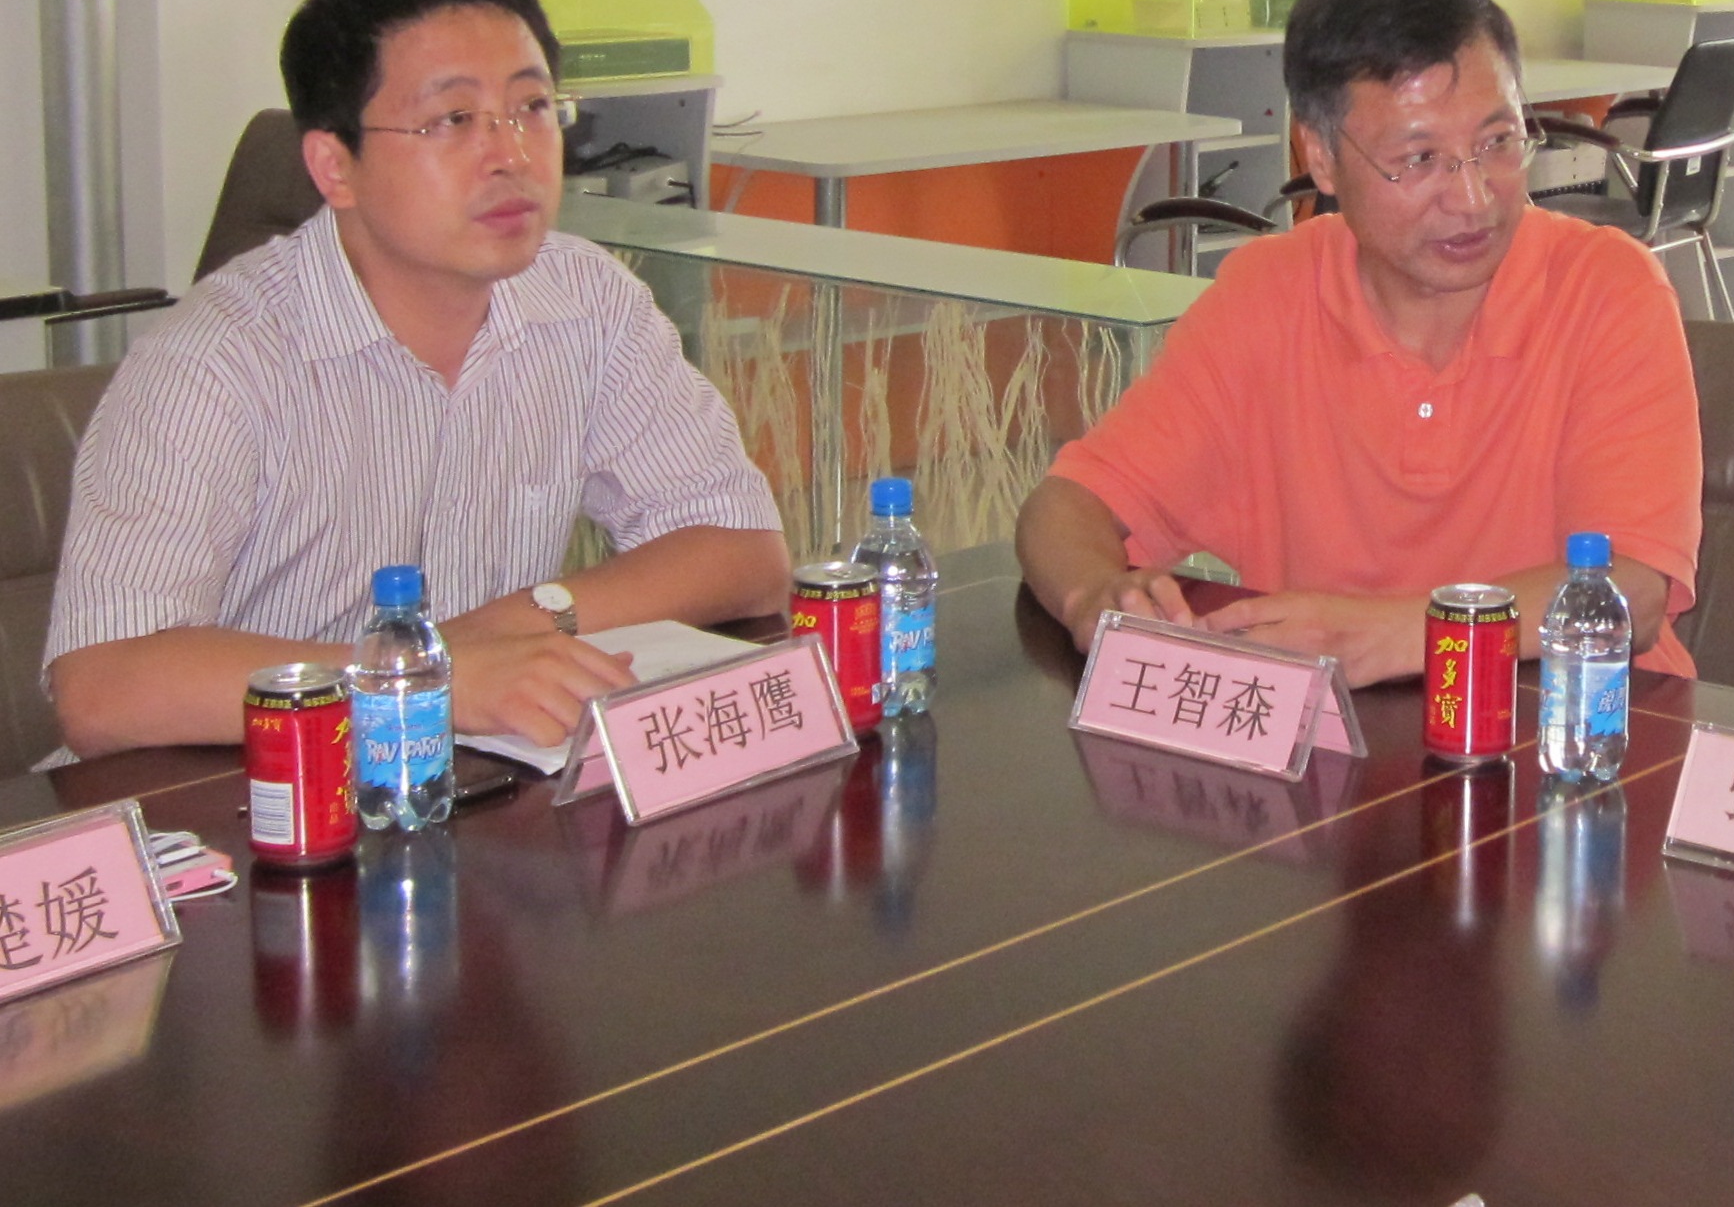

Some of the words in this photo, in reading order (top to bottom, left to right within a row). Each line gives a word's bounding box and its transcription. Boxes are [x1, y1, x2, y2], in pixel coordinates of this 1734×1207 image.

[637, 669, 804, 774] 张海鹰
[1109, 658, 1276, 741] 王智森
